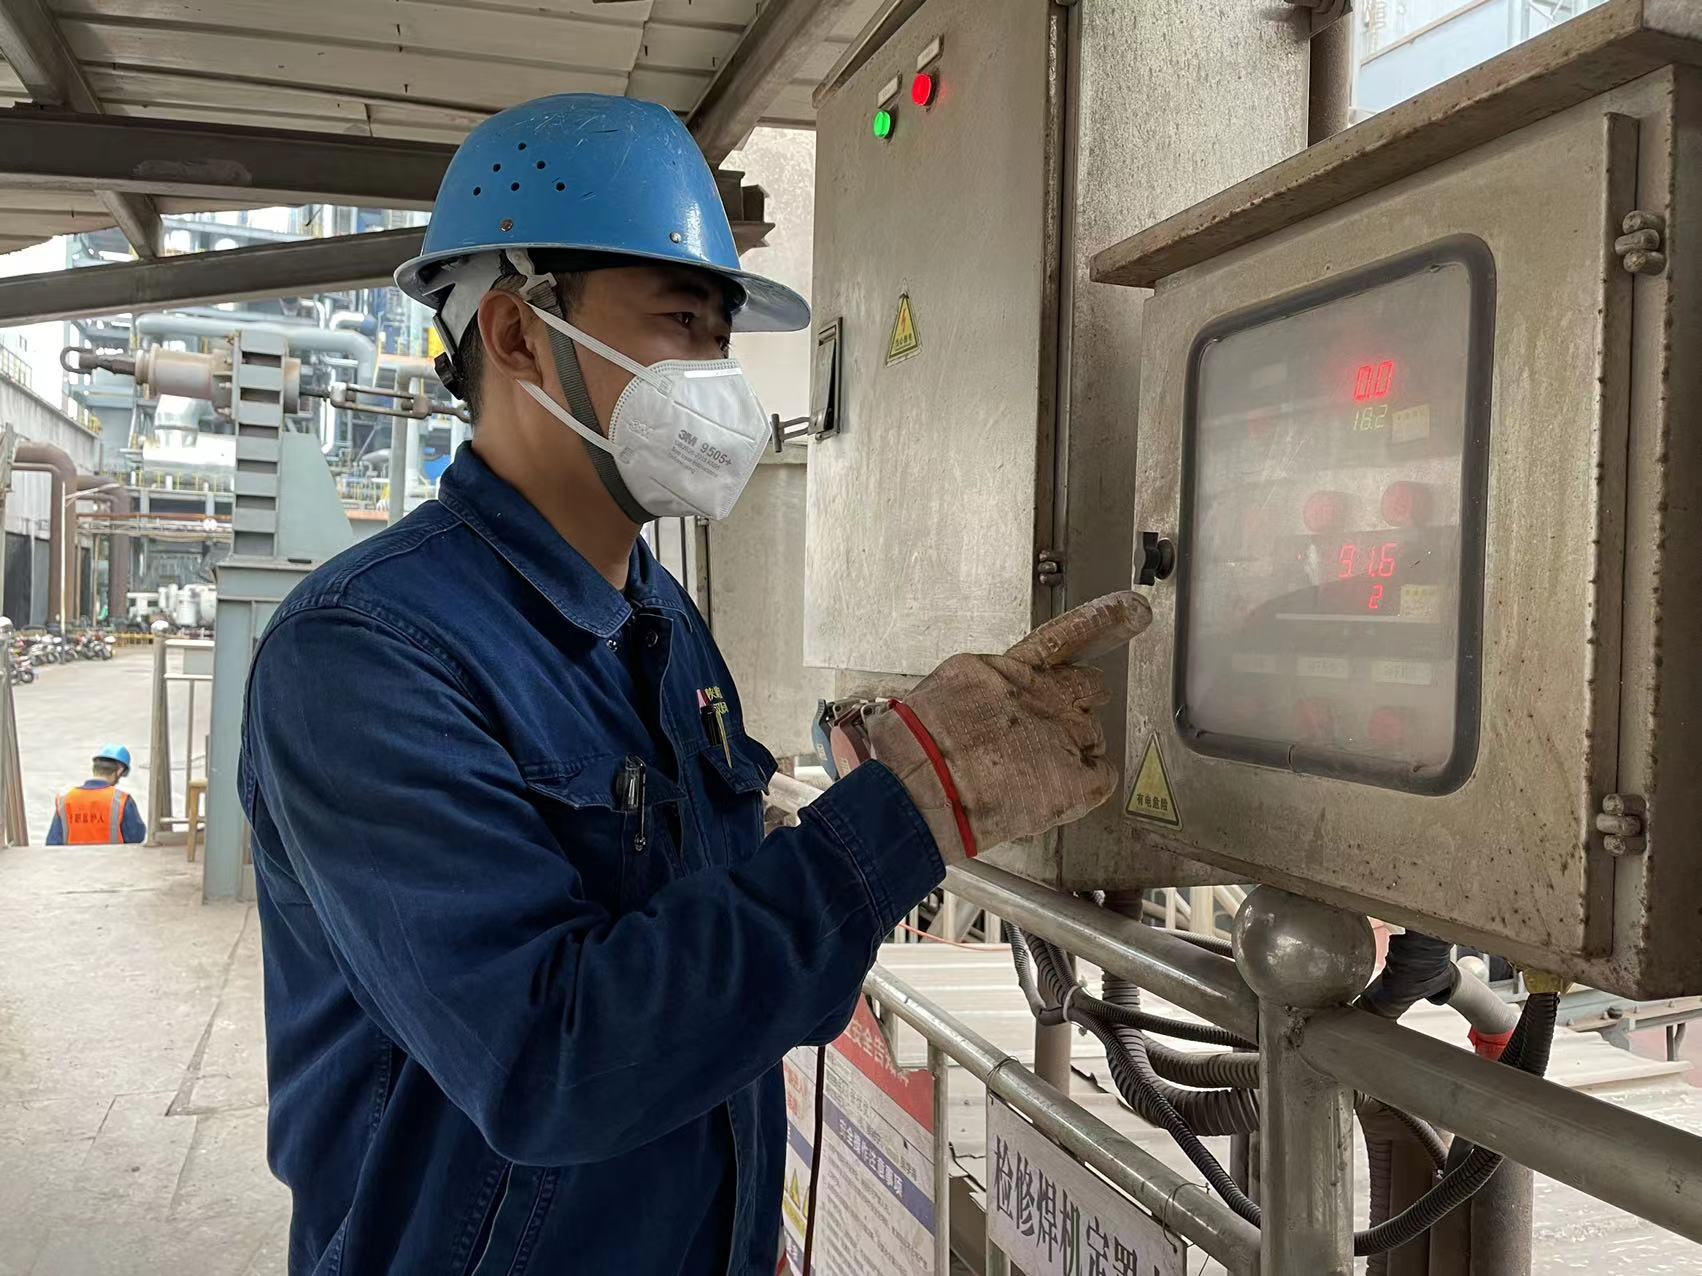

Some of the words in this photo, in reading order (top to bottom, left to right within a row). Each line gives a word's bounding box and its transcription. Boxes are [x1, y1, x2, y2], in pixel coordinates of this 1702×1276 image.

[678, 429, 698, 447] 3M
[700, 442, 733, 467] 9505+
[1368, 583, 1384, 610] 2
[1136, 792, 1169, 812] 有电危险
